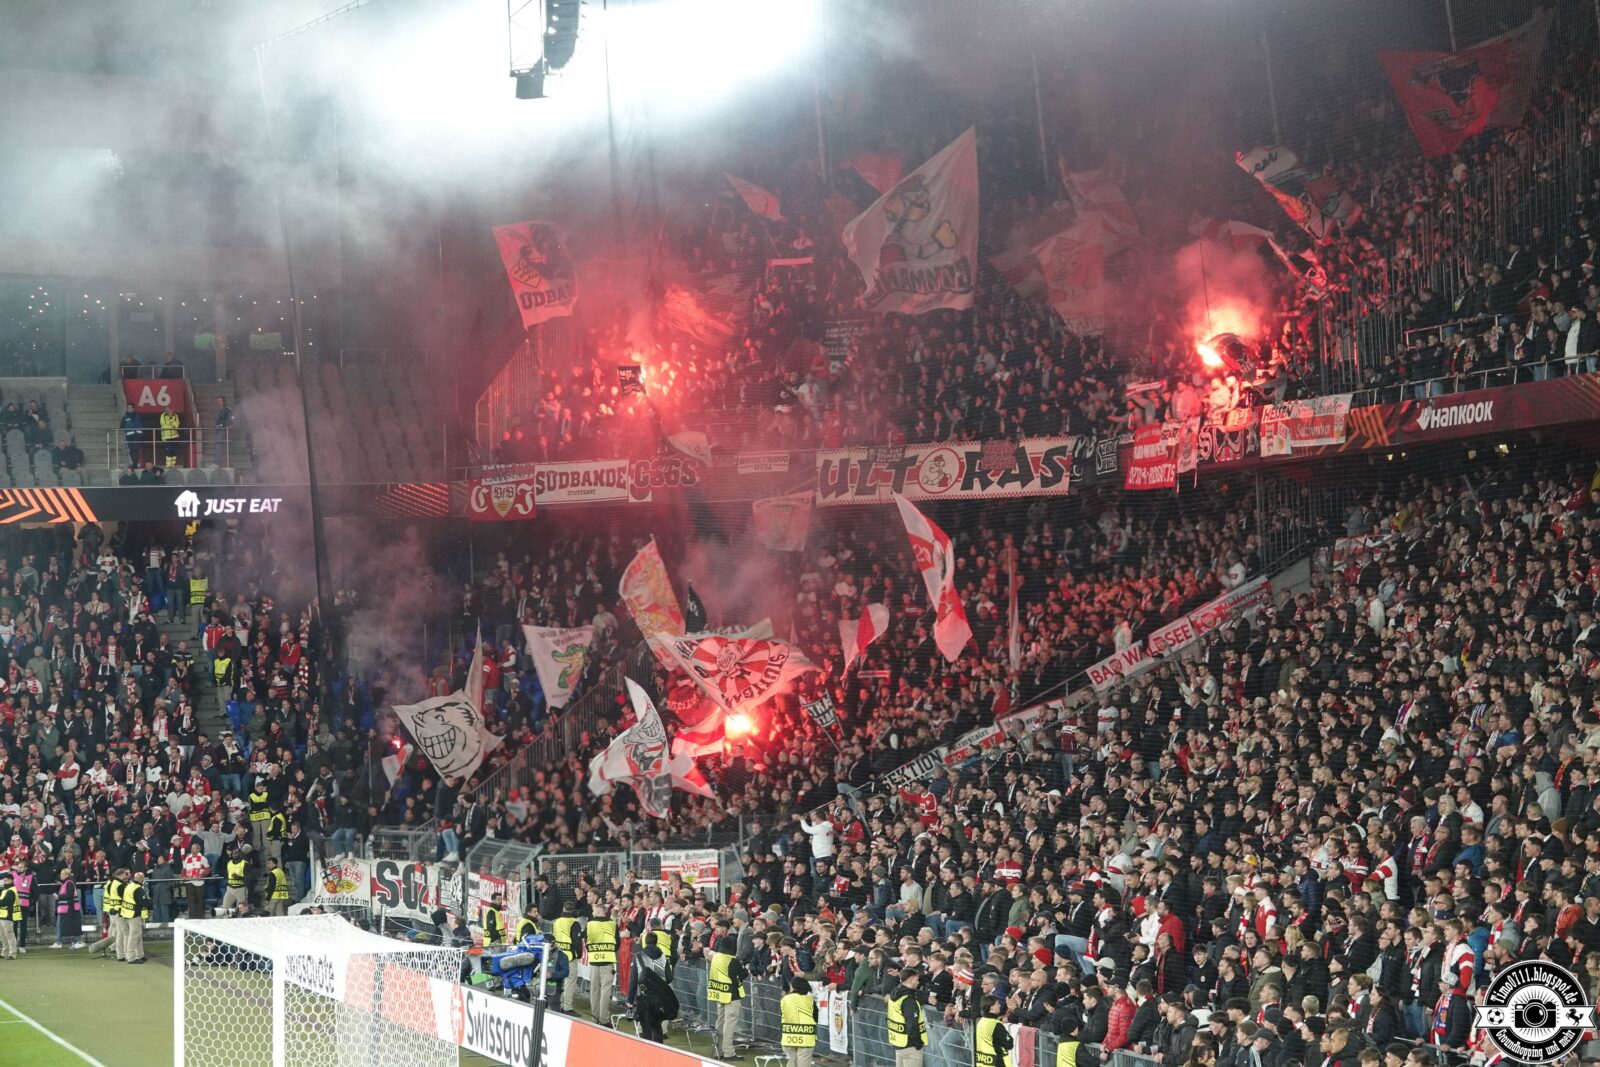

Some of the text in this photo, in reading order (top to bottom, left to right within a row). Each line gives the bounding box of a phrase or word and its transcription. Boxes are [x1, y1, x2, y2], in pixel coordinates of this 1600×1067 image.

[138, 385, 171, 406] A6
[535, 466, 627, 496] SÜDBANDE
[204, 498, 282, 516] JUST EAT
[1090, 658, 1123, 685] BAD
[314, 895, 370, 907] Gundelsheim
[588, 943, 615, 951] STEWARD
[708, 981, 730, 992] EWARD
[466, 990, 548, 1067] Swissquoe
[783, 1024, 814, 1033] TEWARD
[787, 1036, 804, 1044] 005
